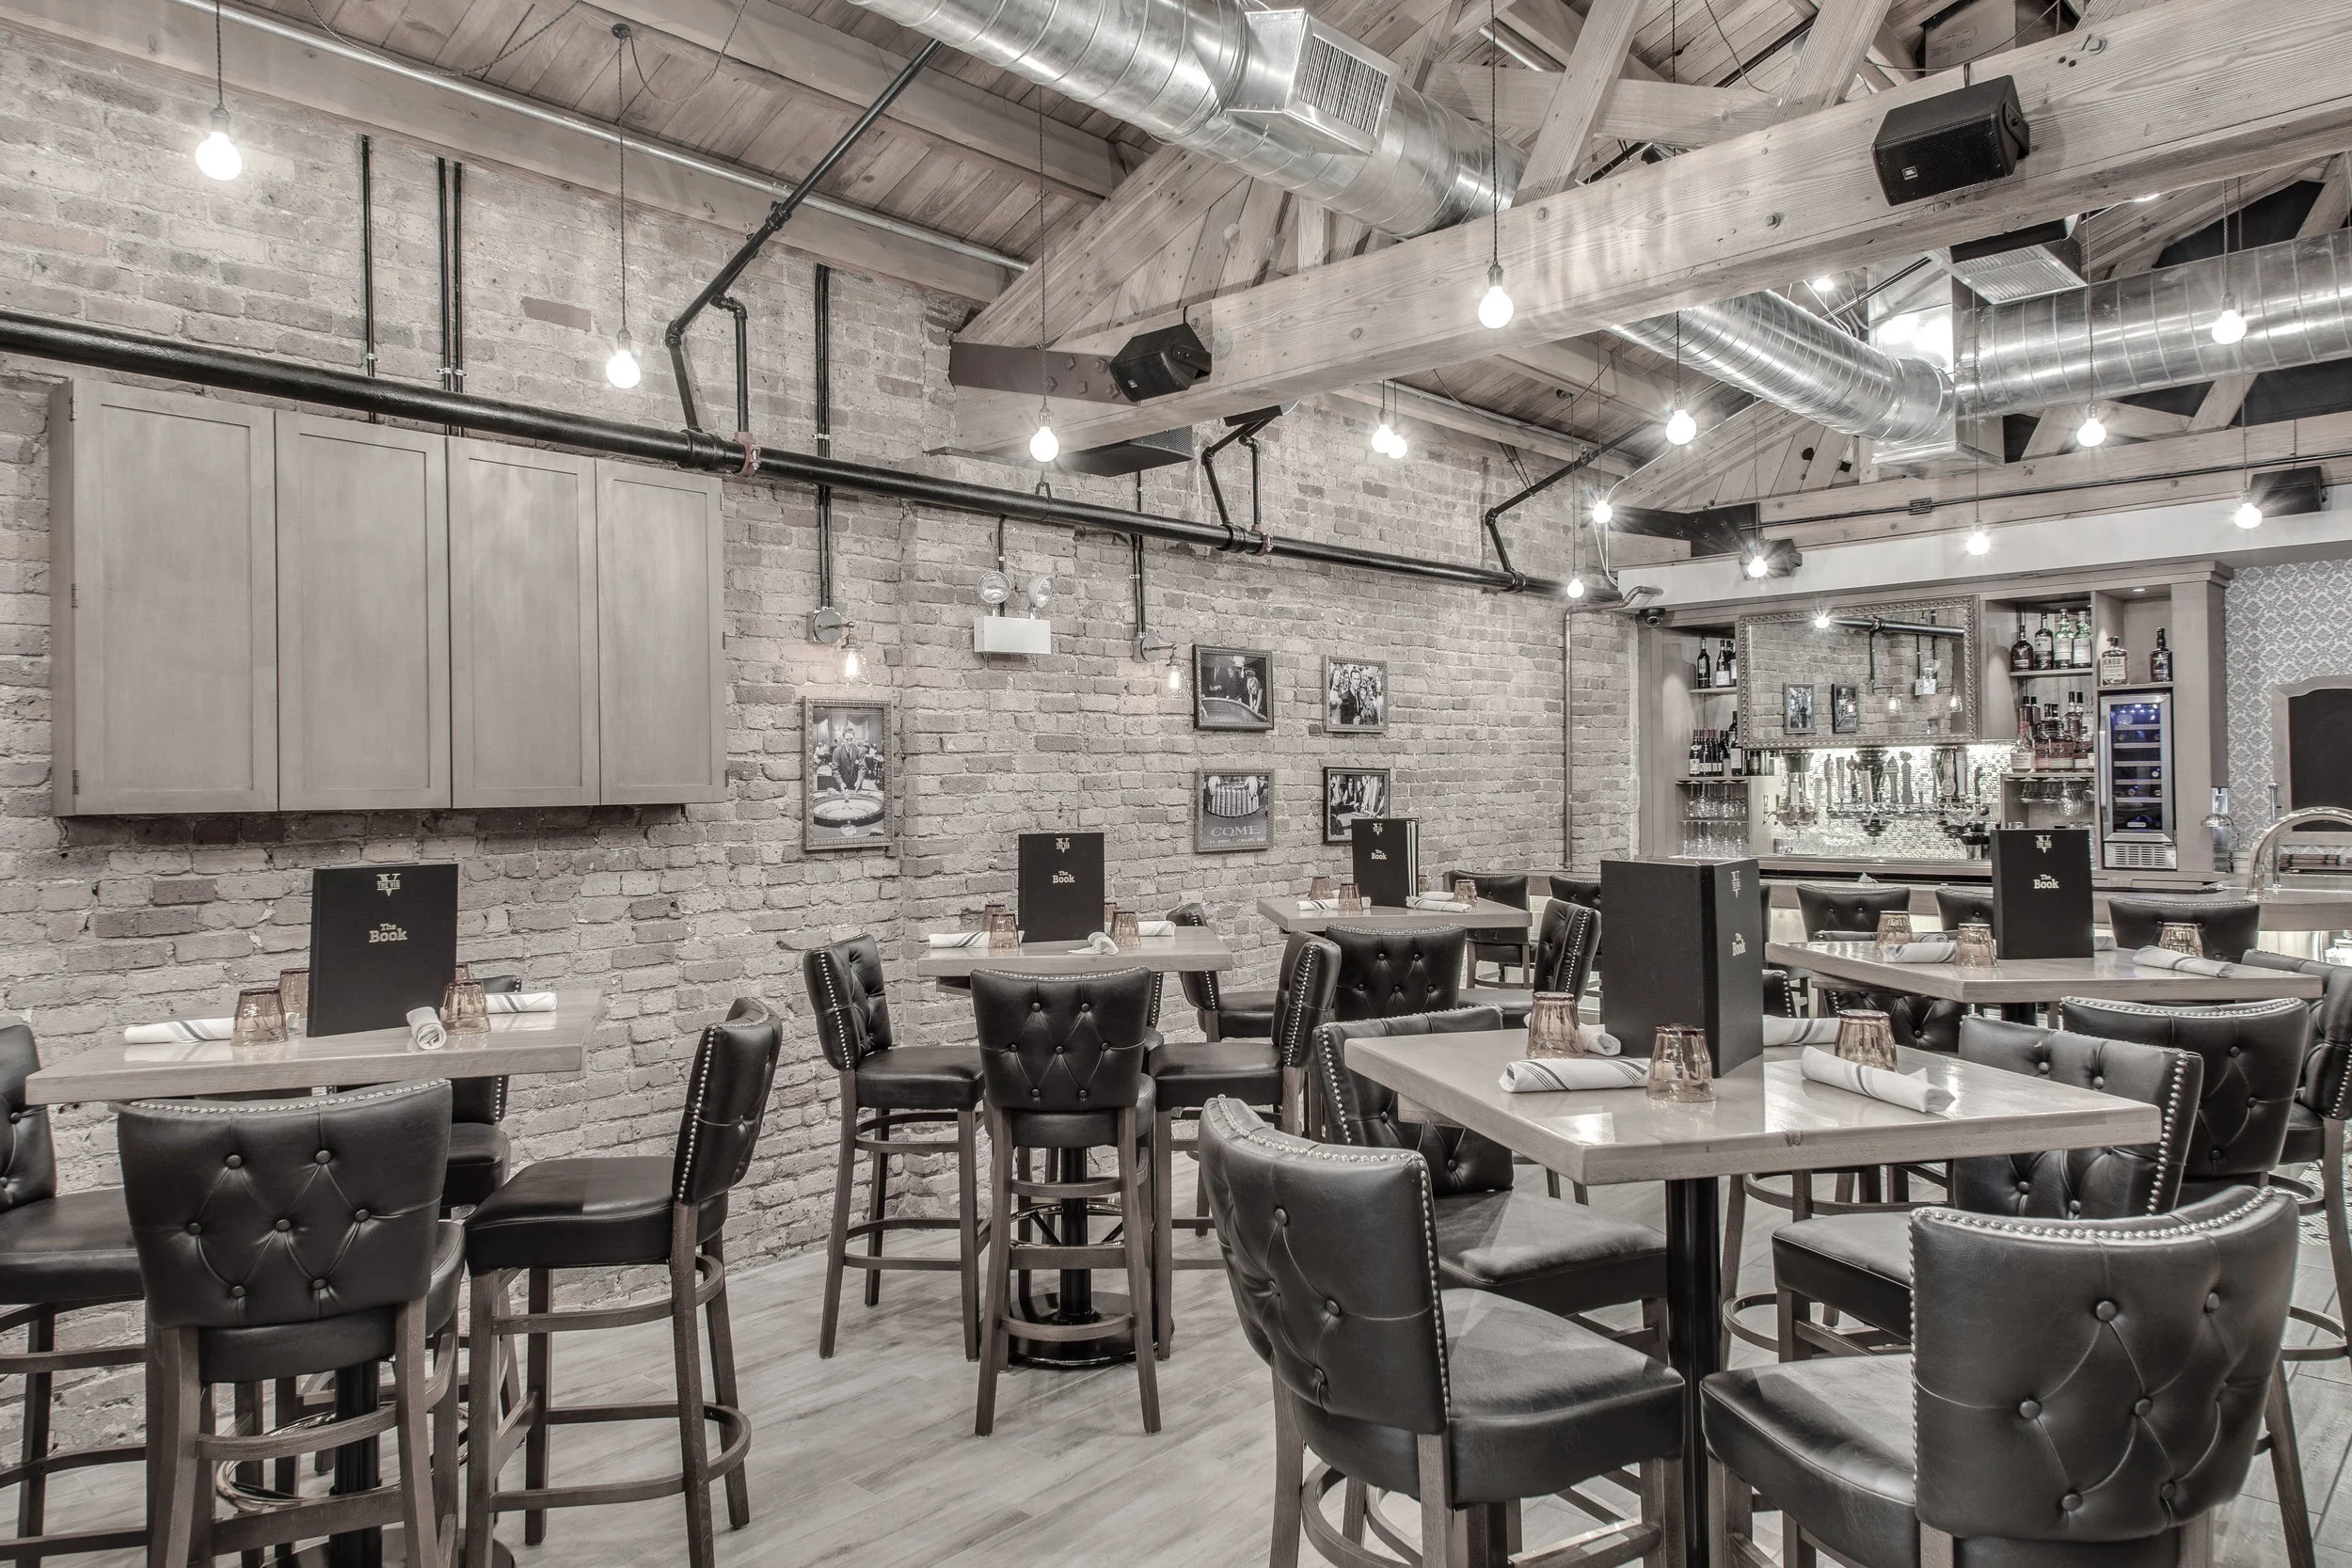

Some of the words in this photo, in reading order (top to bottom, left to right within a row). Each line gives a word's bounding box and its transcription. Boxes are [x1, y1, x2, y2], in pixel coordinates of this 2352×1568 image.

[1052, 874, 1075, 884] Book
[2033, 879, 2059, 889] Book
[379, 923, 396, 931] The
[368, 927, 407, 943] Book
